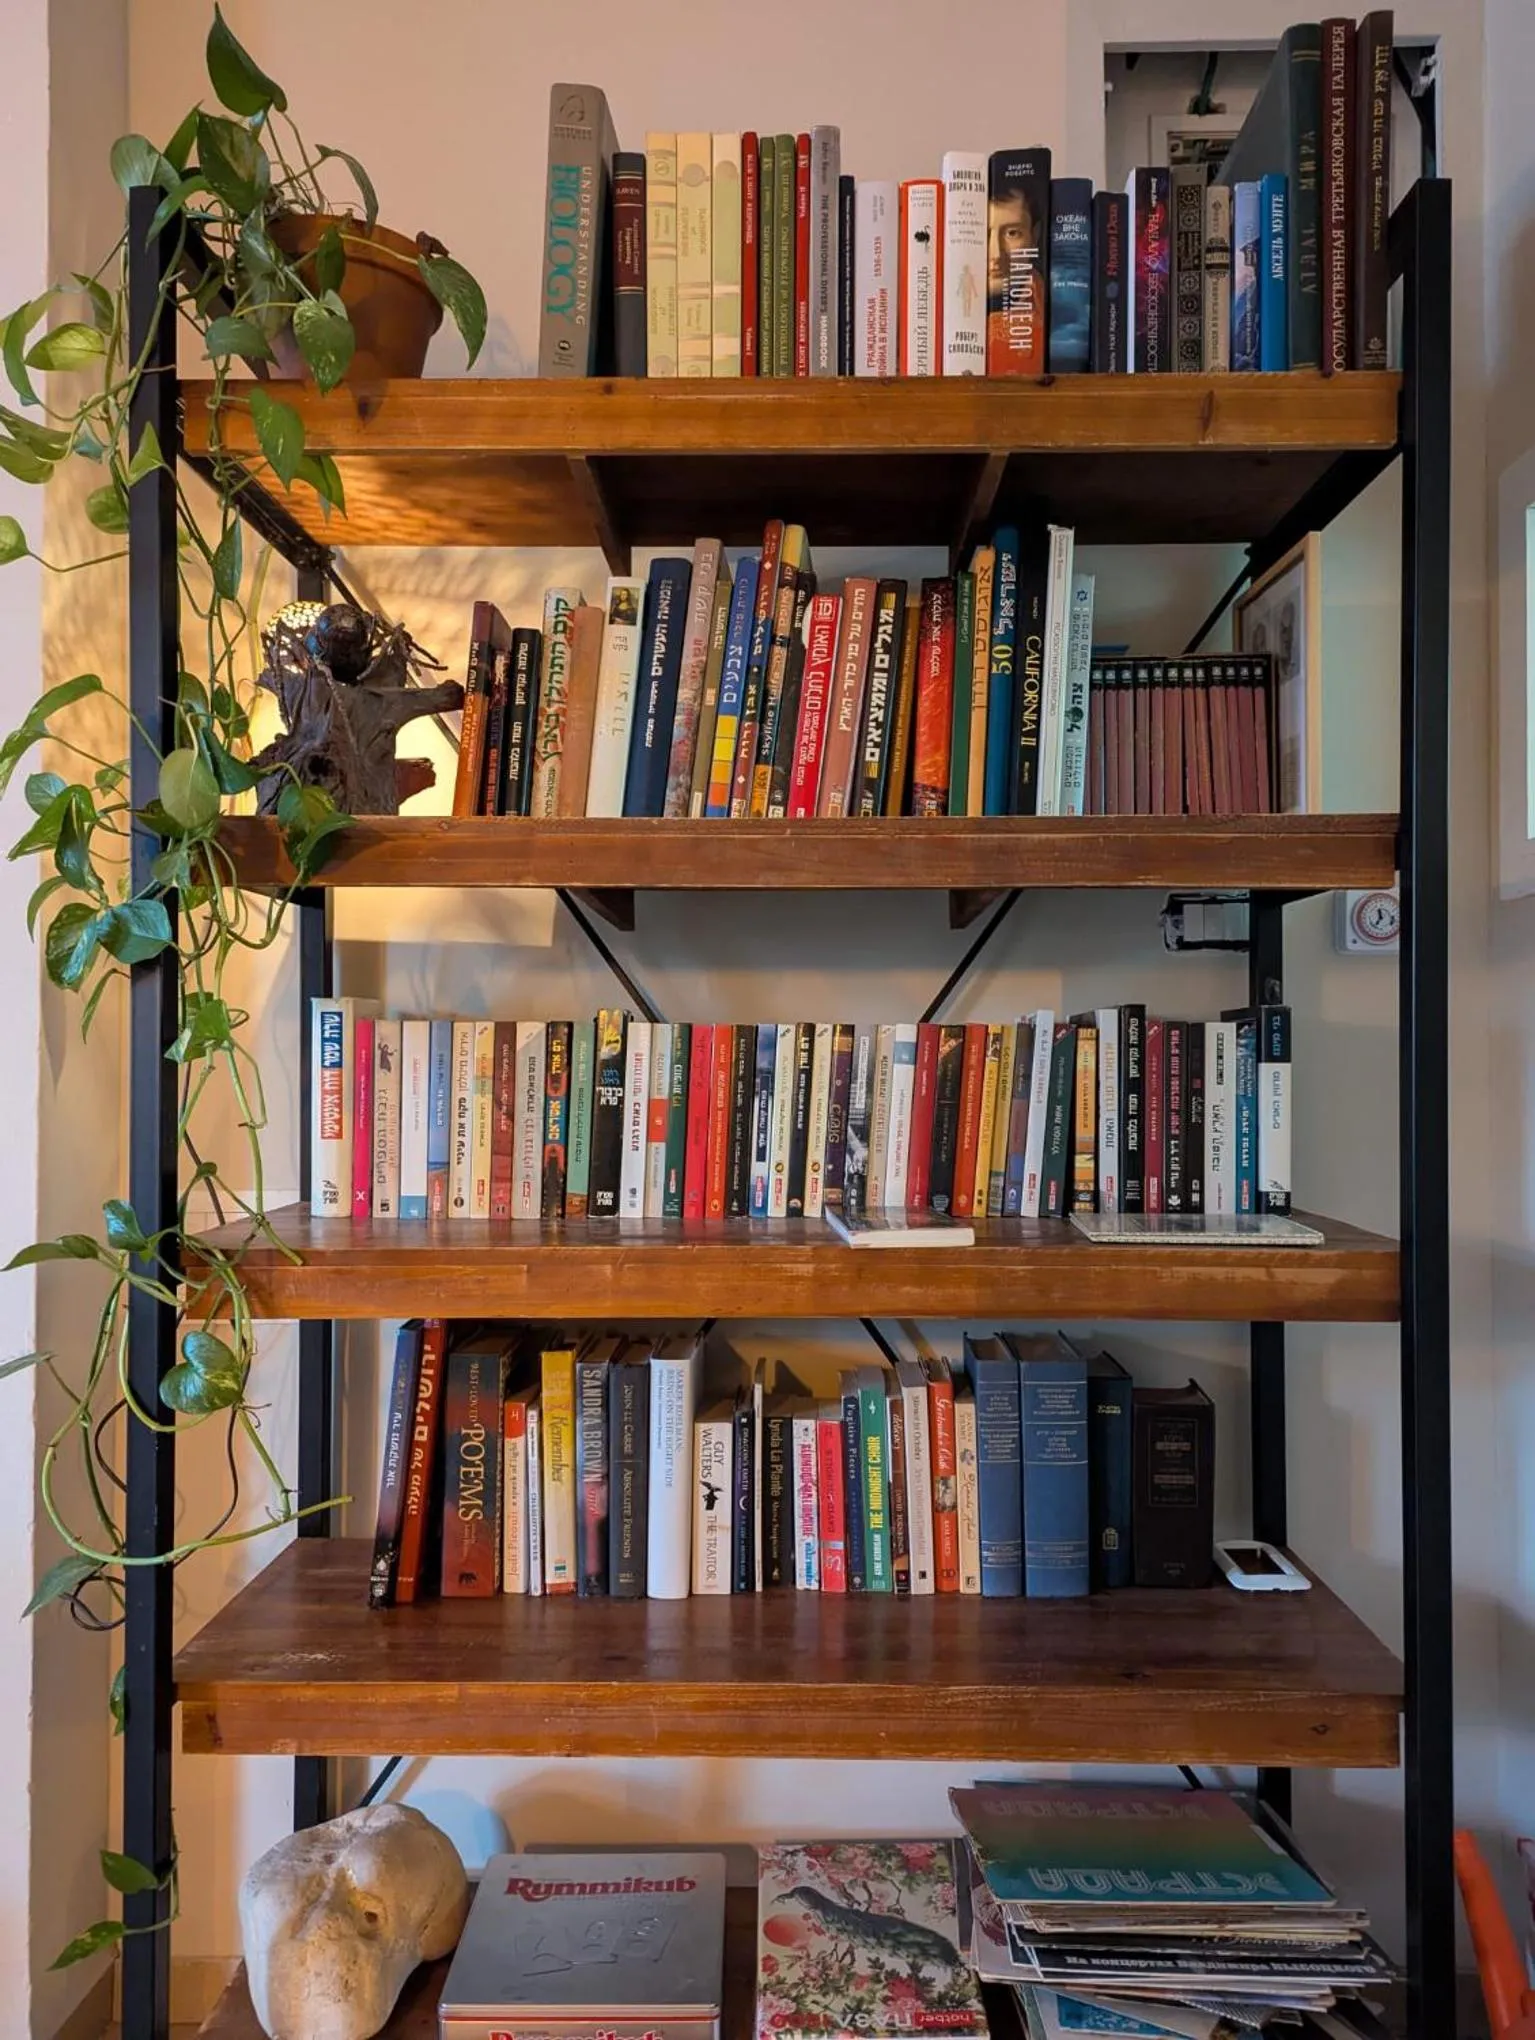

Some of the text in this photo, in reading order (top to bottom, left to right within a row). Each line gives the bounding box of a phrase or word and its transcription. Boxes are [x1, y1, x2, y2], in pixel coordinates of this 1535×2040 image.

[746, 176, 754, 199] LIGHT
[1299, 131, 1316, 191] МИРА
[820, 195, 829, 210] THE
[1056, 214, 1086, 225] ОКЕАН
[1062, 223, 1080, 233] ВНЕ
[1331, 24, 1347, 372] ОСУДАРСТВЕННАЯ ТРЕТЬЯКОВСКАЯ ГАЛЕРЕЯ
[547, 163, 582, 323] BIOLOGY
[575, 165, 593, 327] UNDERSTANDING
[779, 225, 790, 286] FLOWERING
[819, 211, 829, 276] PROFESSIONAL
[1053, 231, 1089, 242] ЗАКОНА
[1147, 213, 1160, 266] НАЧАЛО
[1272, 193, 1286, 281] АКСЕЛЬ МУНТЕ
[779, 302, 790, 366] PHYSIOLOGY
[820, 315, 829, 369] HANDBOOK
[866, 297, 877, 369] ГРАЖДАНСКАЯ
[914, 266, 930, 377] ЕРНЫЙ ЛЕБЕДЬ
[798, 346, 807, 369] LIGHT
[695, 552, 713, 623] בני קשת
[851, 588, 867, 619] החיים
[932, 592, 943, 623] לגלות
[991, 551, 1016, 676] ישראל 50
[649, 579, 673, 677] המאה העשרים
[846, 643, 860, 657] פני
[848, 623, 863, 640] על
[931, 626, 942, 641] את
[971, 565, 991, 713] אוגוסט רודן
[542, 597, 575, 761] קום התהלך בארץ
[723, 644, 742, 703] צבעים
[739, 584, 769, 759] ירושלים אבן ורוח
[806, 624, 831, 711] האומץ לחלום
[864, 608, 896, 763] מגלים וממציאים
[1020, 635, 1041, 747] CALIFORNIA II
[760, 671, 778, 756] Skyline Haifa
[321, 1013, 341, 1067] שרה שמר
[1129, 1017, 1140, 1045] שלמה
[321, 1070, 341, 1139] דוח אינטימי
[456, 1122, 466, 1138] את
[457, 1096, 468, 1116] פקח
[1127, 1118, 1138, 1151] בלהבות
[376, 1128, 388, 1184] הספרים
[1211, 1137, 1222, 1172] הטובה
[390, 1411, 402, 1427] עיר
[582, 1369, 603, 1483] SANDRA BROWN
[623, 1384, 635, 1409] JOHN
[406, 1344, 436, 1515] ירושלים של מעלה
[550, 1414, 570, 1483] Remember
[701, 1427, 713, 1479] WALTERS
[713, 1441, 725, 1466] GUY
[767, 1418, 784, 1497] Lynda La Plante
[845, 1403, 857, 1480] Fugitive Pieces
[912, 1431, 924, 1461] October
[458, 1423, 486, 1521] POEMS
[867, 1435, 884, 1530] THE MIDNIGHT CHOIR
[623, 1468, 635, 1558] ABSOLUTE FRIENDS
[705, 1514, 718, 1581] THE TRAITOR
[503, 1875, 697, 1903] Rummikub
